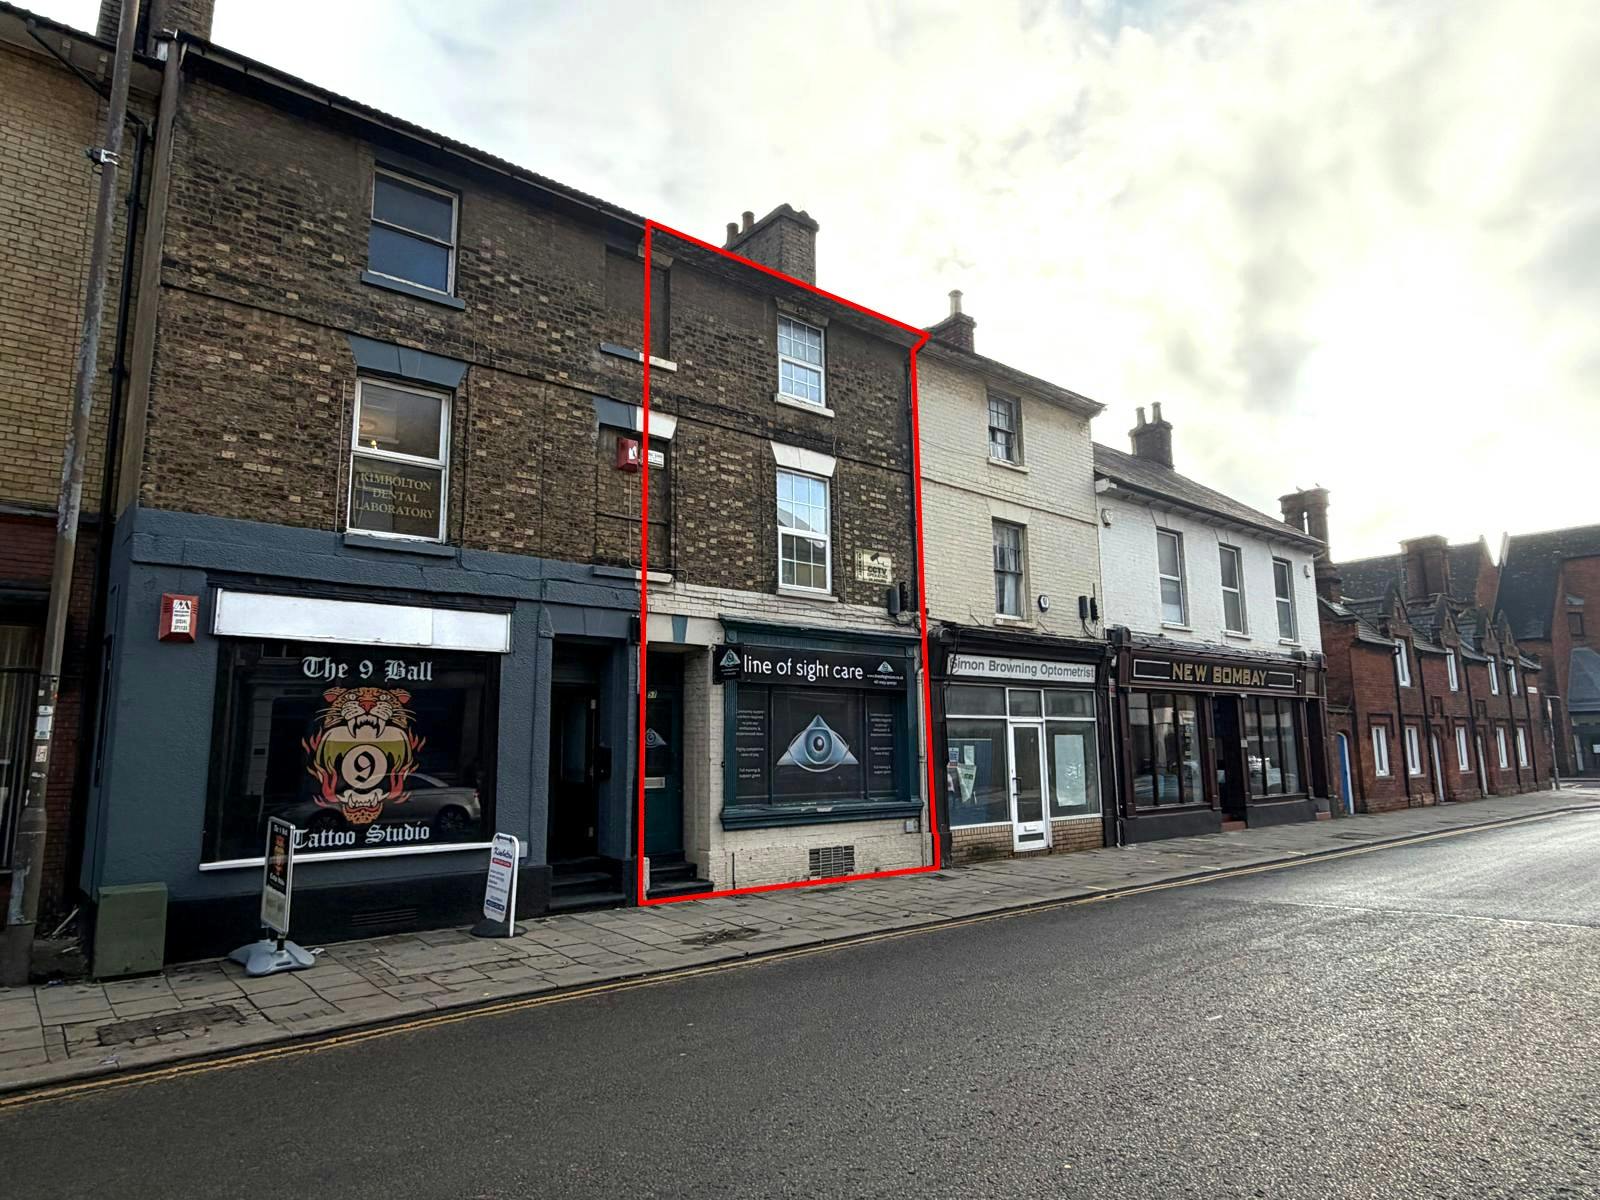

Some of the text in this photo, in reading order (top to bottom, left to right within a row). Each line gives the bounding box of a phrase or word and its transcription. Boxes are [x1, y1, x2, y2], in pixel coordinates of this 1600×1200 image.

[360, 472, 432, 491] KIMBOLTON
[373, 488, 420, 504] DENTAL
[355, 500, 435, 519] LABORATORY
[867, 566, 887, 575] CCTV
[302, 656, 433, 682] The 9 Ball
[744, 654, 772, 675] line
[776, 658, 793, 676] of
[796, 660, 830, 683] sight
[833, 665, 863, 680] care
[950, 656, 1095, 678] Simon Browning Optometrist
[1172, 662, 1268, 687] NEW BOMBAY
[353, 751, 376, 783] 9
[293, 829, 356, 849] Tattoo
[365, 821, 430, 844] Studio
